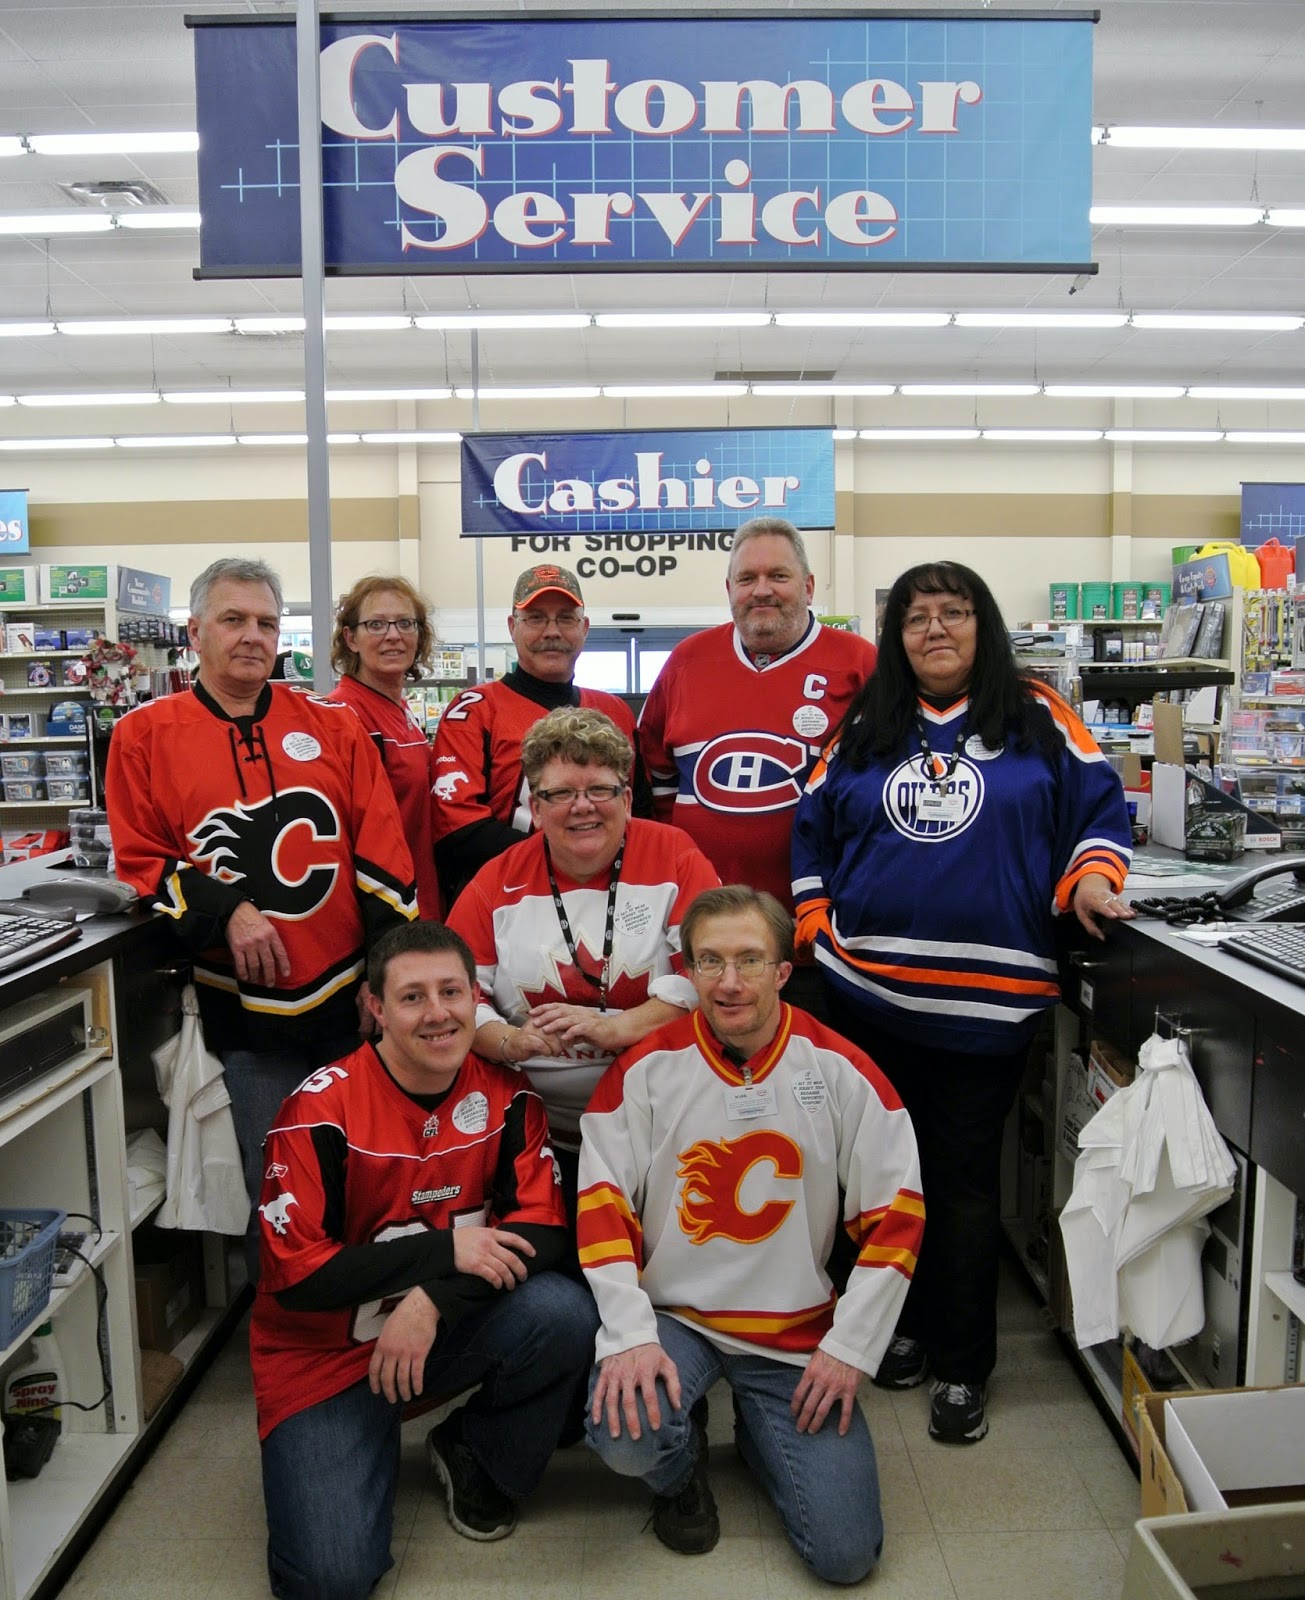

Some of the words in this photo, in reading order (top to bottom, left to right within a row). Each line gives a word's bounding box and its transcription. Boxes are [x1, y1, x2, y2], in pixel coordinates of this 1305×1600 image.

[319, 32, 981, 142] Customer
[392, 145, 898, 252] Service
[493, 451, 800, 516] Cashier
[511, 535, 570, 553] FOR
[585, 533, 736, 553] SHOPPING
[576, 557, 677, 579] CO-OP
[803, 673, 828, 700] C
[446, 691, 483, 720] 2
[556, 1049, 618, 1060] ANA
[290, 1065, 350, 1096] 5
[424, 1128, 438, 1137] CFL
[411, 1185, 461, 1202] Stampeders
[12, 1384, 57, 1398] Spray
[16, 1396, 50, 1409] Nine
